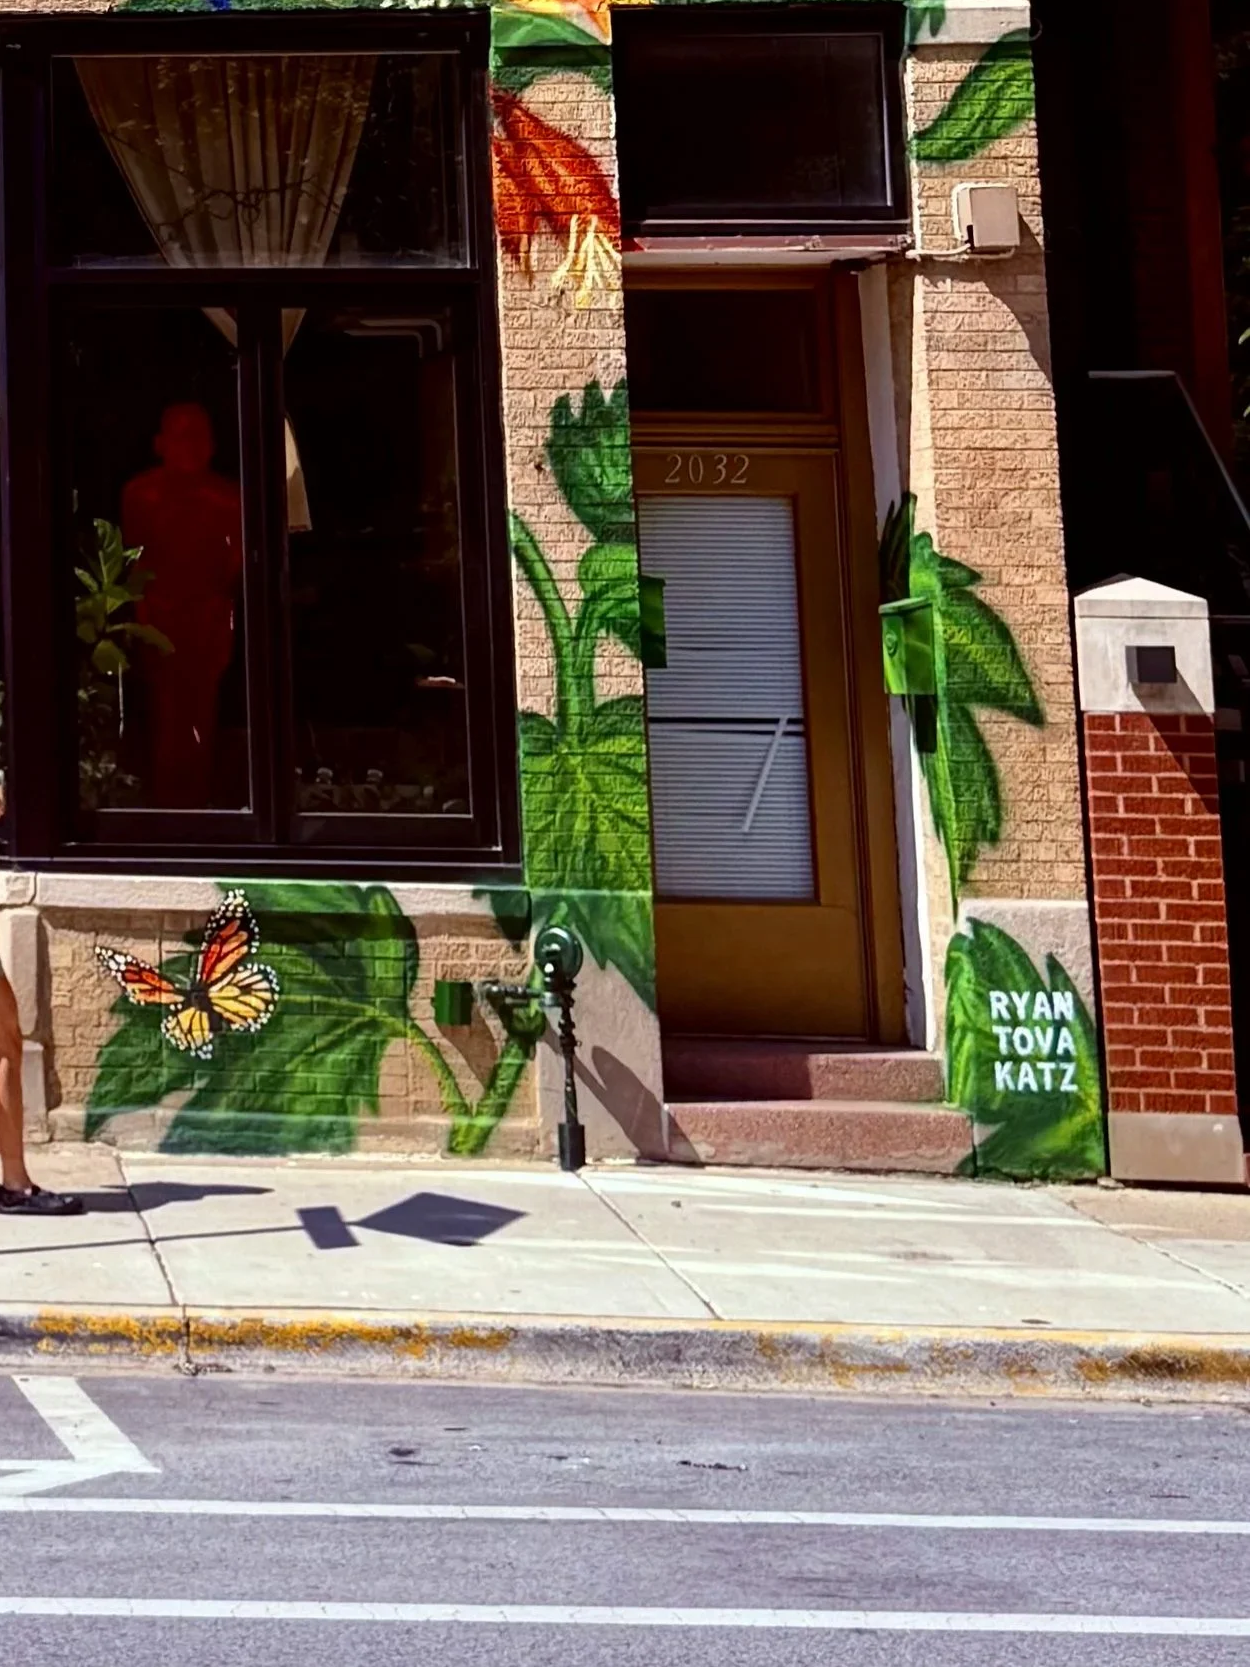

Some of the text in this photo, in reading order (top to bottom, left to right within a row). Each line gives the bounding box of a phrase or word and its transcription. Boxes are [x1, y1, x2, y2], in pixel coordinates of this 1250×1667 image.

[665, 454, 749, 484] 2032
[989, 990, 1075, 1021] RYAN
[992, 1025, 1076, 1056] TOVA
[994, 1061, 1079, 1093] KATZ
